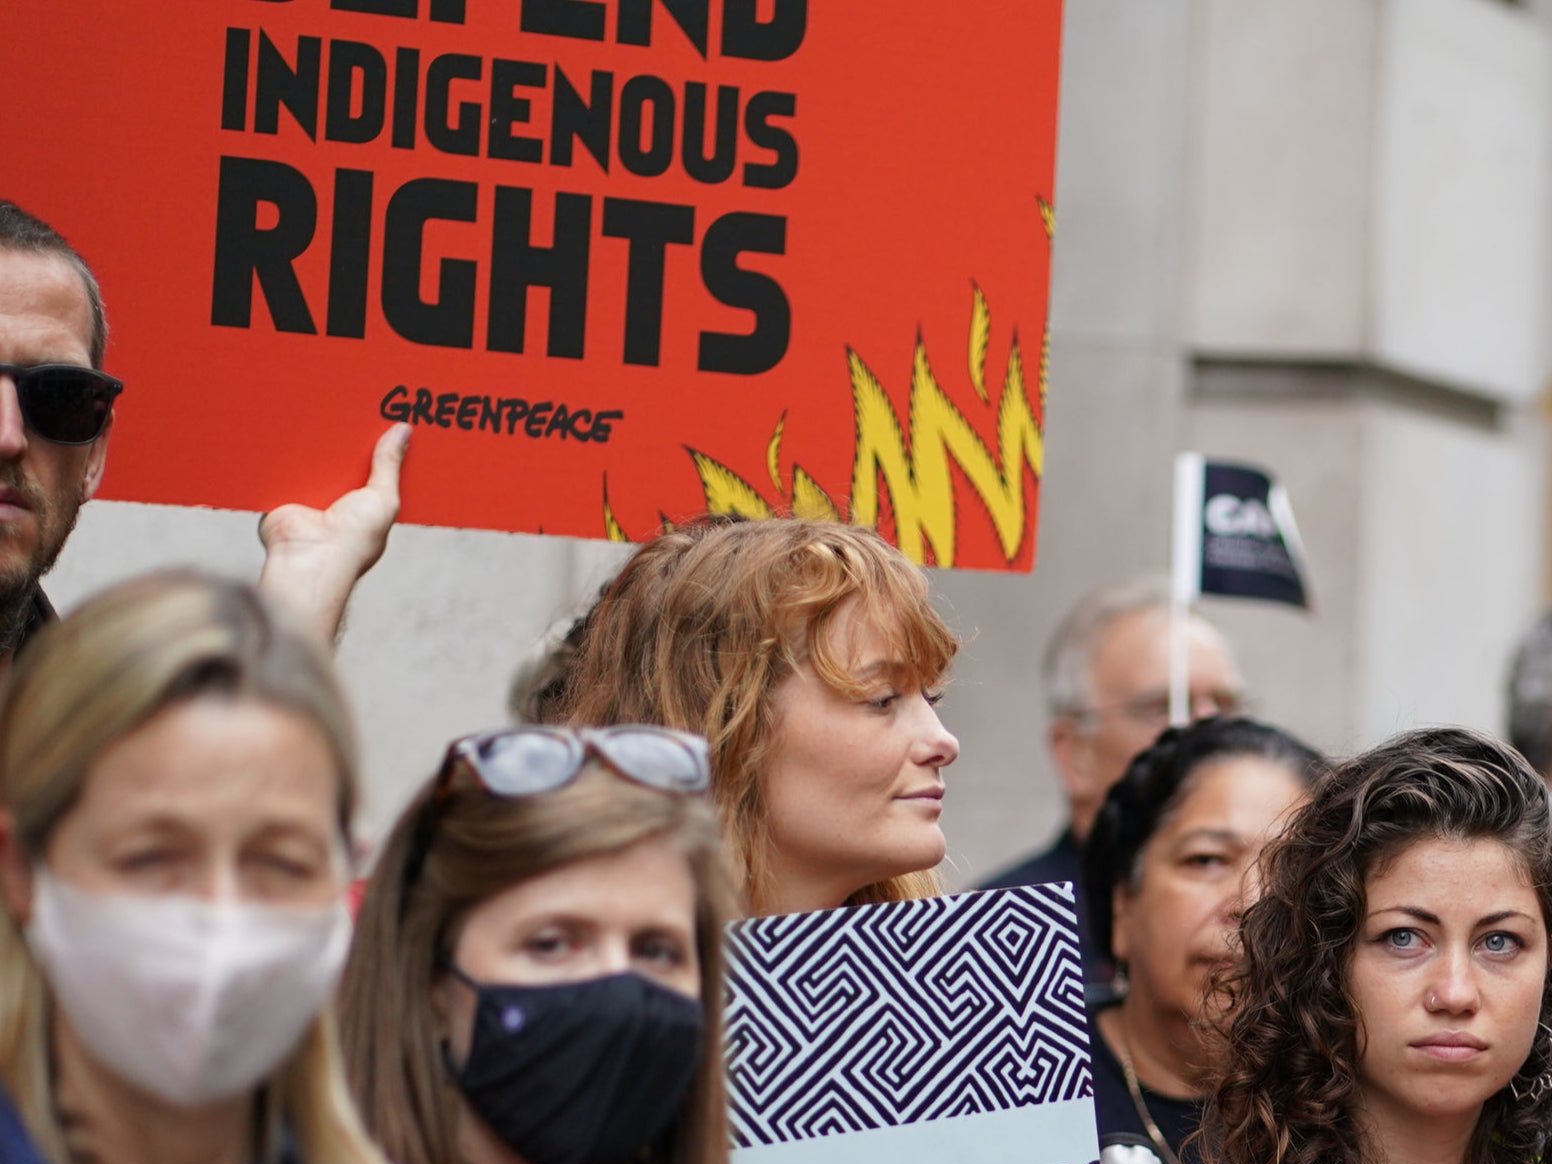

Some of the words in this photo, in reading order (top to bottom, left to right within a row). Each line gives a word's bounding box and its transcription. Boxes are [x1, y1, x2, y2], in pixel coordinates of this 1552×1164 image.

[220, 27, 800, 190] INDIGENOUS
[210, 155, 793, 376] RIGHTS
[379, 384, 624, 443] GREENPEACE
